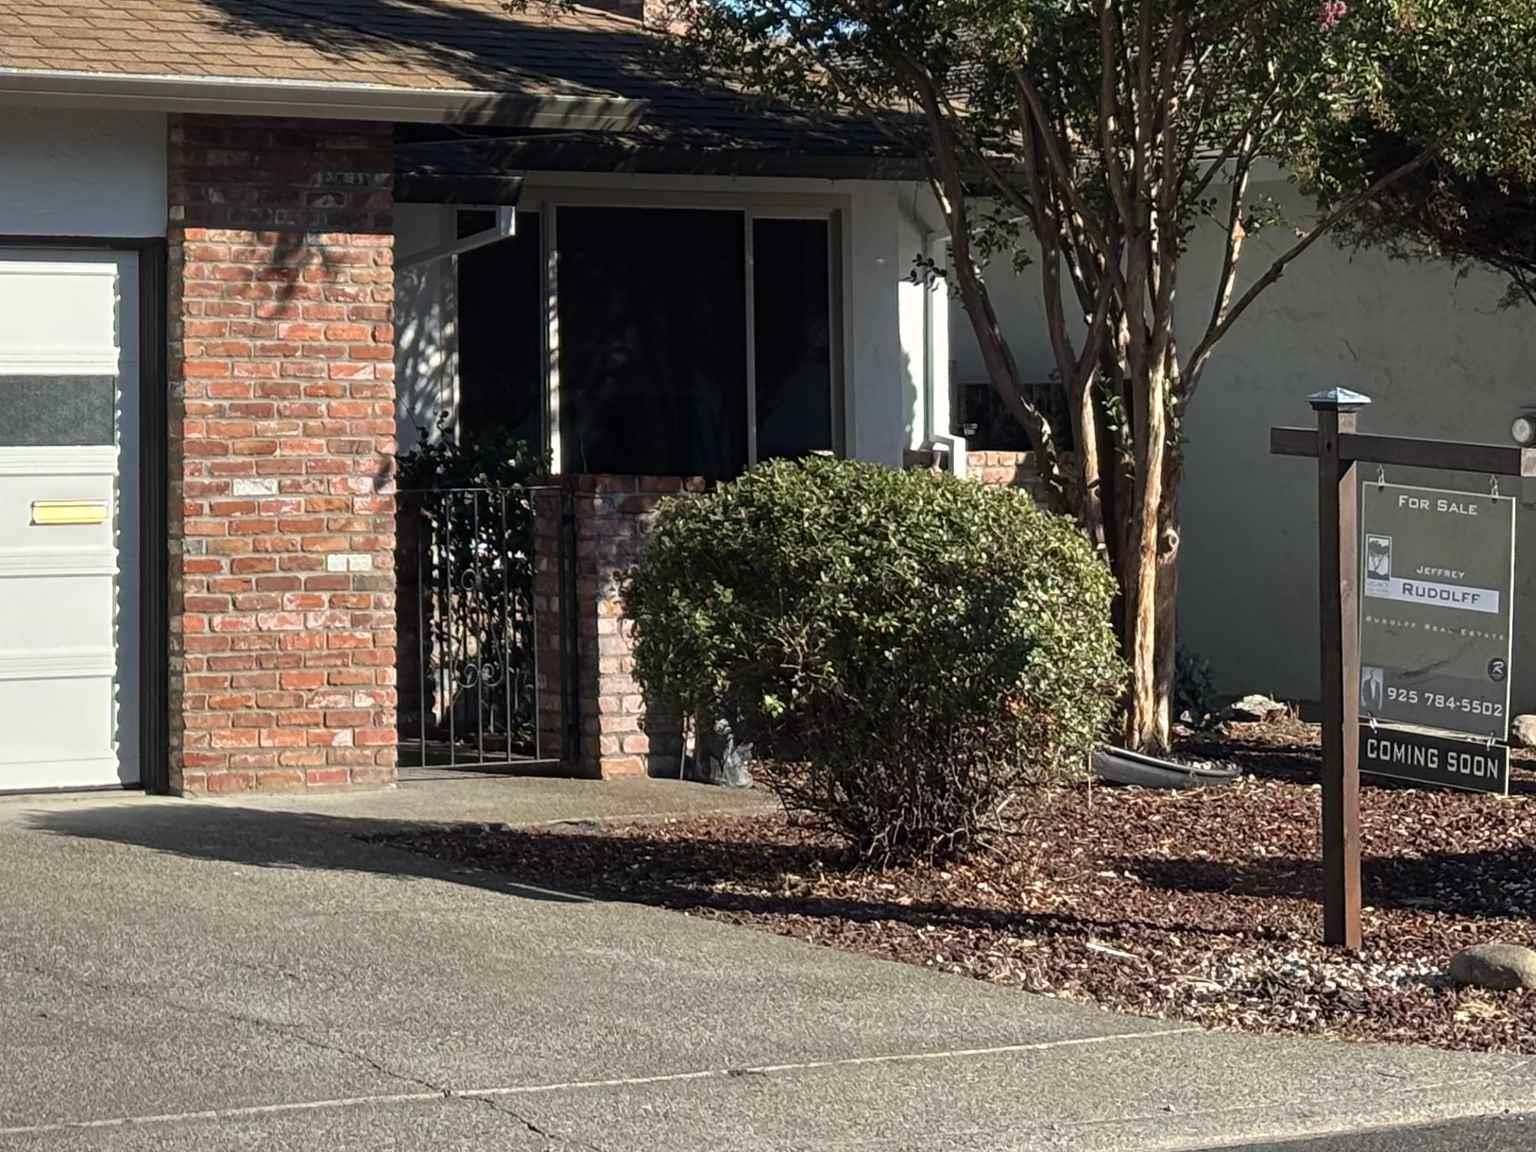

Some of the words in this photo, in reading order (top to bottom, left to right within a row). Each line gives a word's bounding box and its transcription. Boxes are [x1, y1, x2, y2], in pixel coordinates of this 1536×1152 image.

[1398, 495, 1430, 510] FOR
[1437, 499, 1478, 515] SALE
[1416, 565, 1465, 579] JEFFREY
[1402, 582, 1481, 604] RUDOLFF
[1387, 687, 1419, 704] 925
[1367, 738, 1439, 769] COMING
[1447, 751, 1499, 779] SOON
